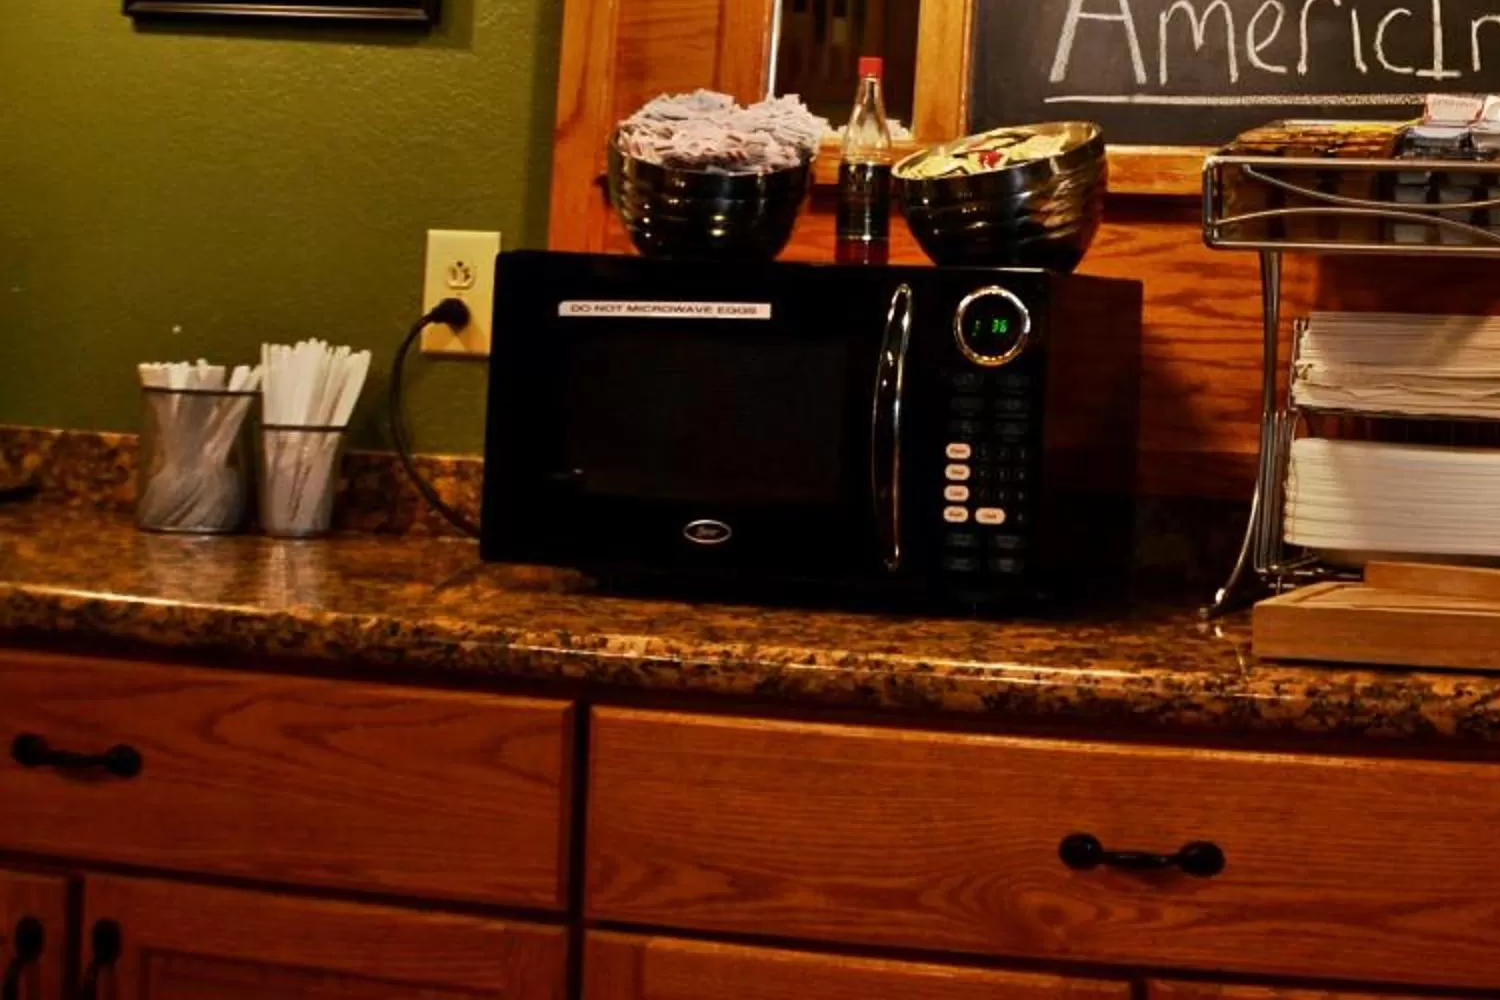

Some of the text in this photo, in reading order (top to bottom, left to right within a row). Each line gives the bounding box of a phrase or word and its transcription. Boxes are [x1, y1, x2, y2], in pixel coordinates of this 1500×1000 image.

[570, 303, 758, 315] DO NOT MICROWAVE EGGS
